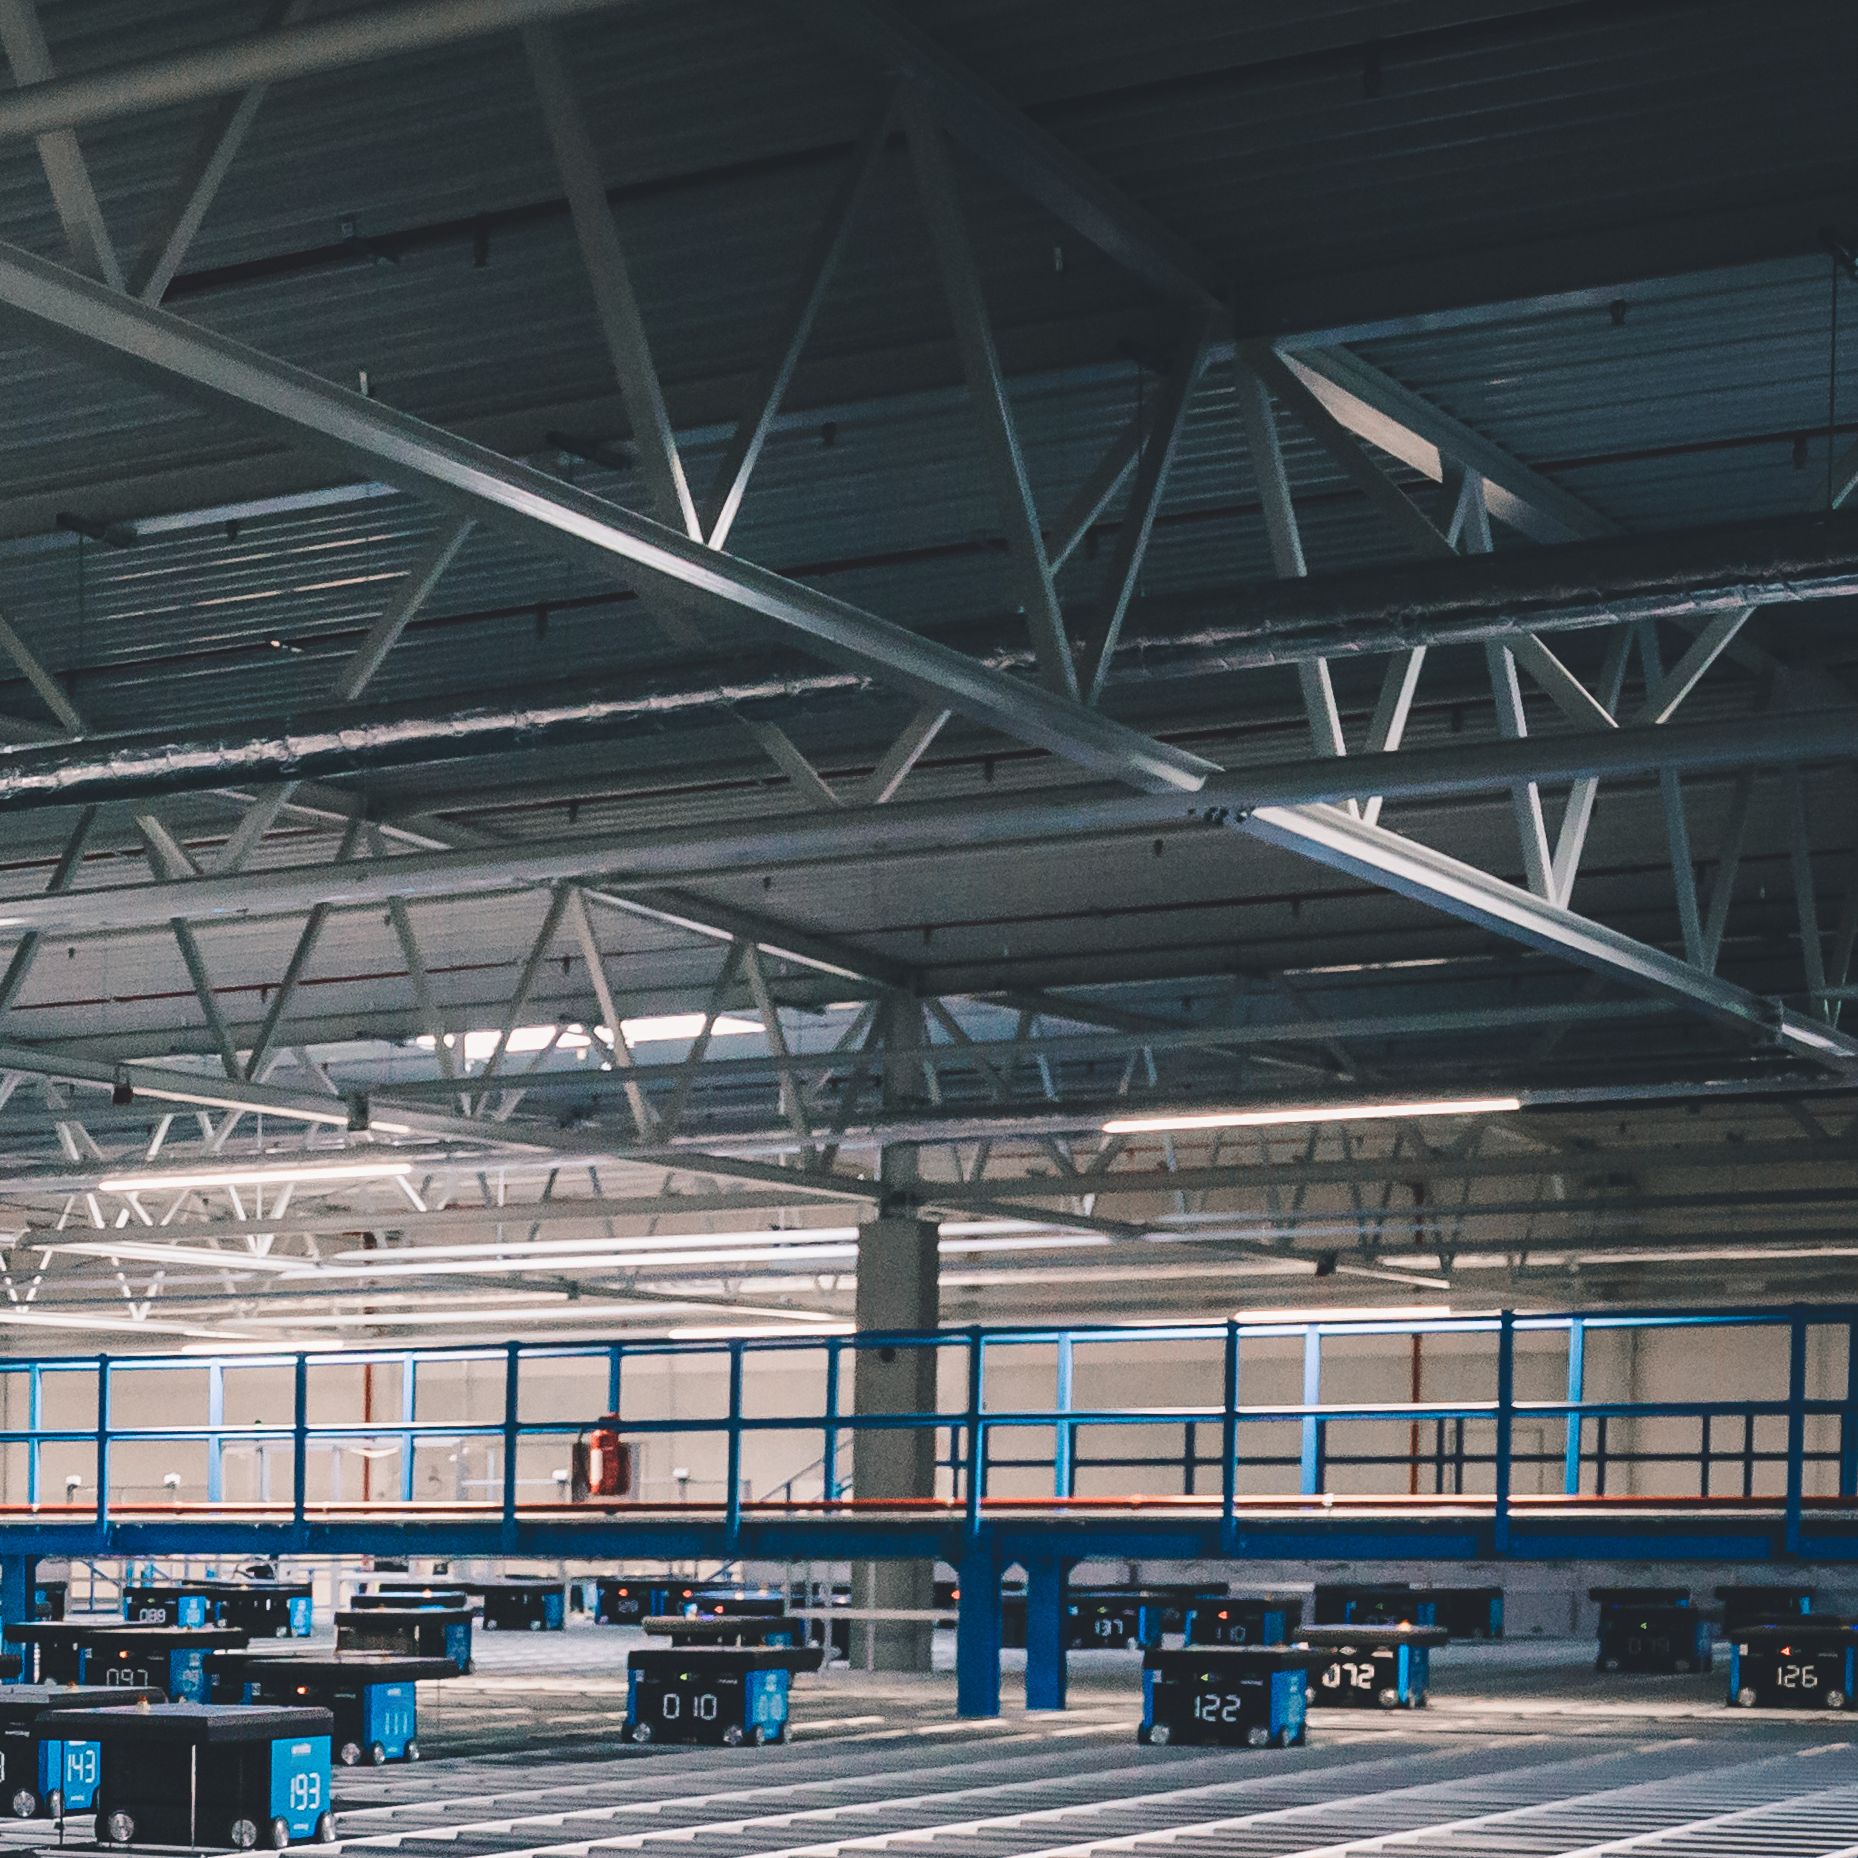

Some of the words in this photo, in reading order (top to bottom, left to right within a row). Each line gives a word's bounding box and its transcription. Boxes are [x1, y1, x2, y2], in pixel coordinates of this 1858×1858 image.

[1322, 1663, 1375, 1689] 072
[1777, 1665, 1819, 1688] 126
[663, 1693, 717, 1720] 010
[1194, 1694, 1241, 1722] 122
[385, 1712, 408, 1735] 111
[67, 1750, 95, 1783] 143
[290, 1772, 321, 1811] 193
